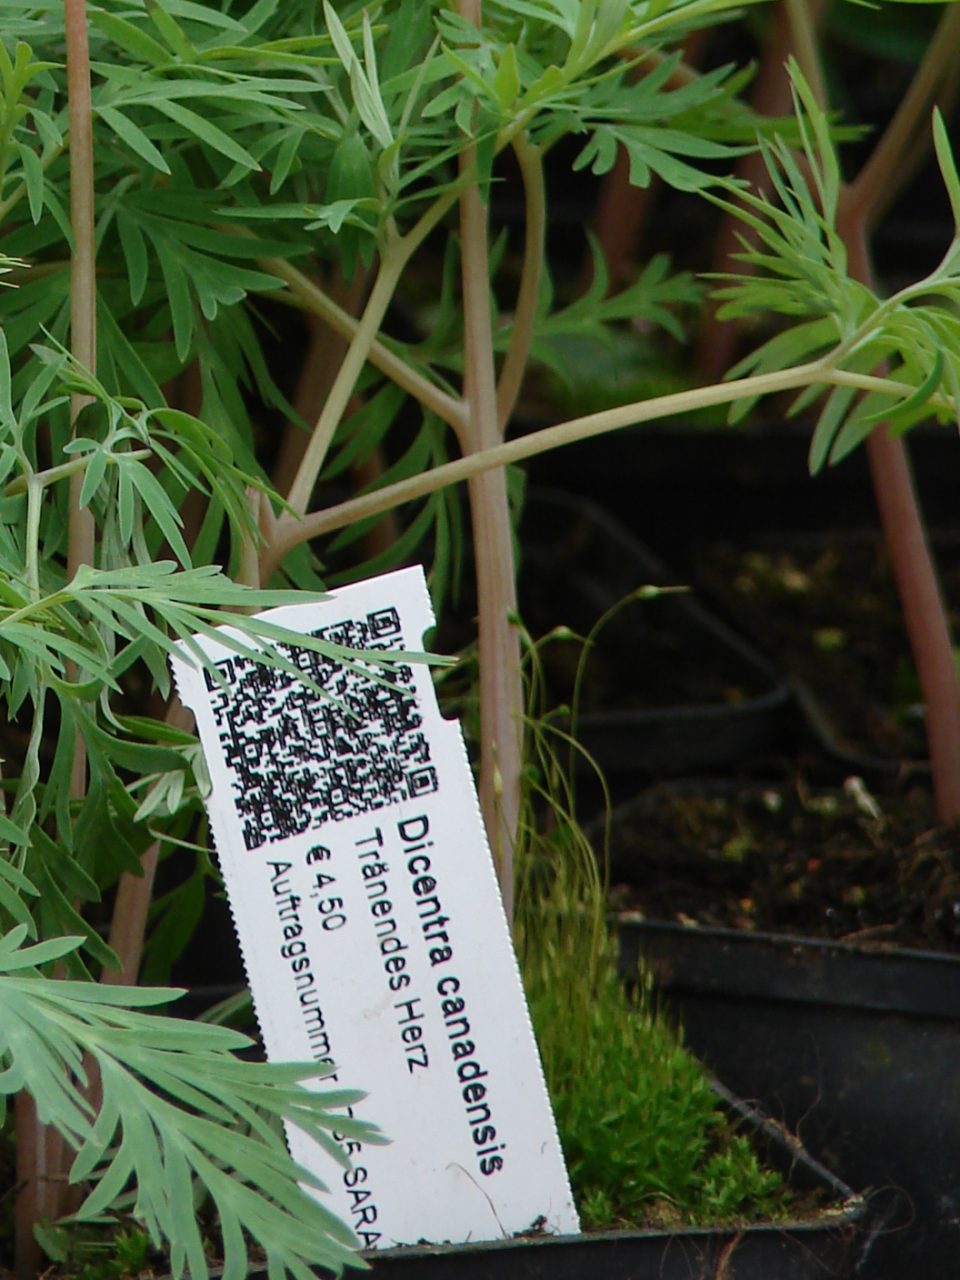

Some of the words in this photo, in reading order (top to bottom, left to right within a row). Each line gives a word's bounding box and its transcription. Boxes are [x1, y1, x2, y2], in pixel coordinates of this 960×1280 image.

[306, 845, 331, 865] €
[309, 873, 347, 932] 4,50
[355, 827, 409, 991] Tränendes
[394, 998, 429, 1074] Herz
[397, 814, 451, 967] Dicentra
[436, 976, 507, 1176] canadensis
